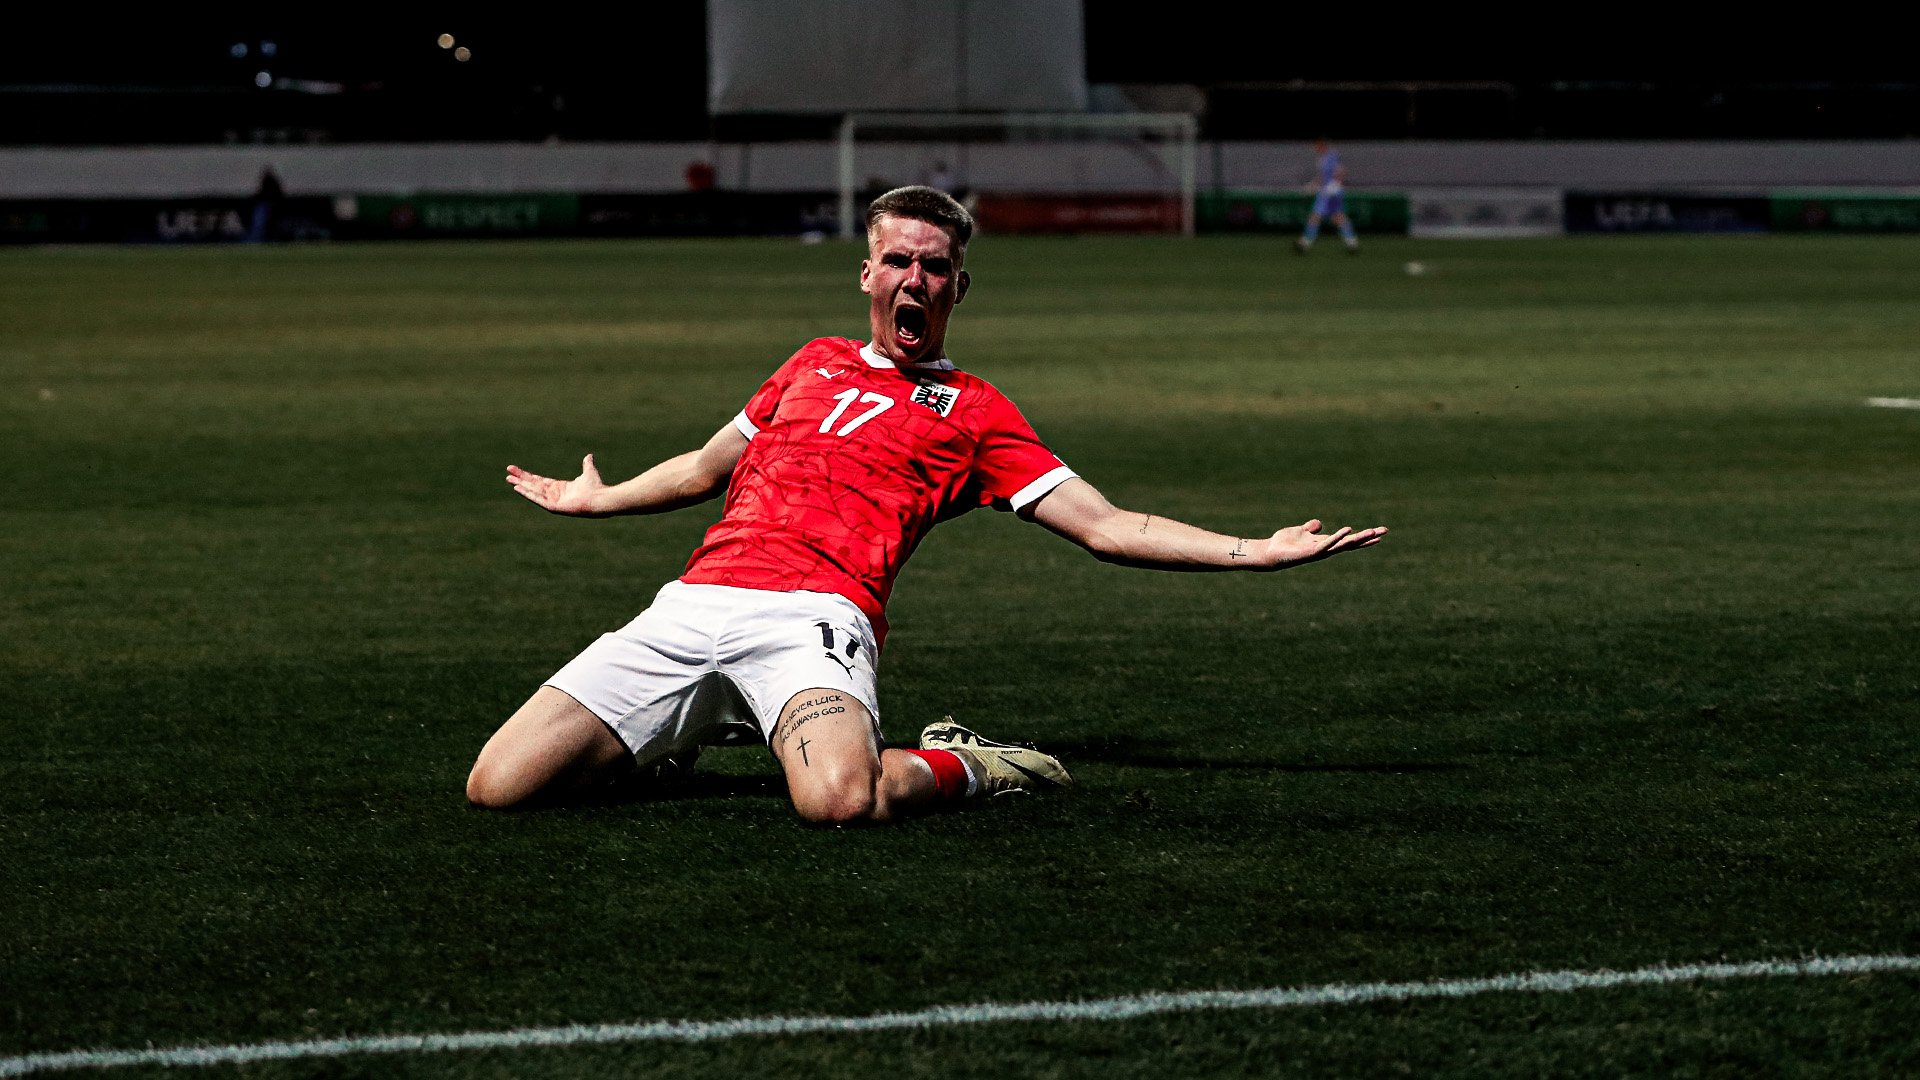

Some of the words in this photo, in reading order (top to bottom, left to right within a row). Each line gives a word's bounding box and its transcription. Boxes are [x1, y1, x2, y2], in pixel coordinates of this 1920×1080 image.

[818, 387, 895, 437] 17
[788, 700, 814, 721] NEVER
[815, 694, 843, 706] LUCK
[791, 711, 820, 733] ALWAYS
[821, 706, 846, 716] GOD
